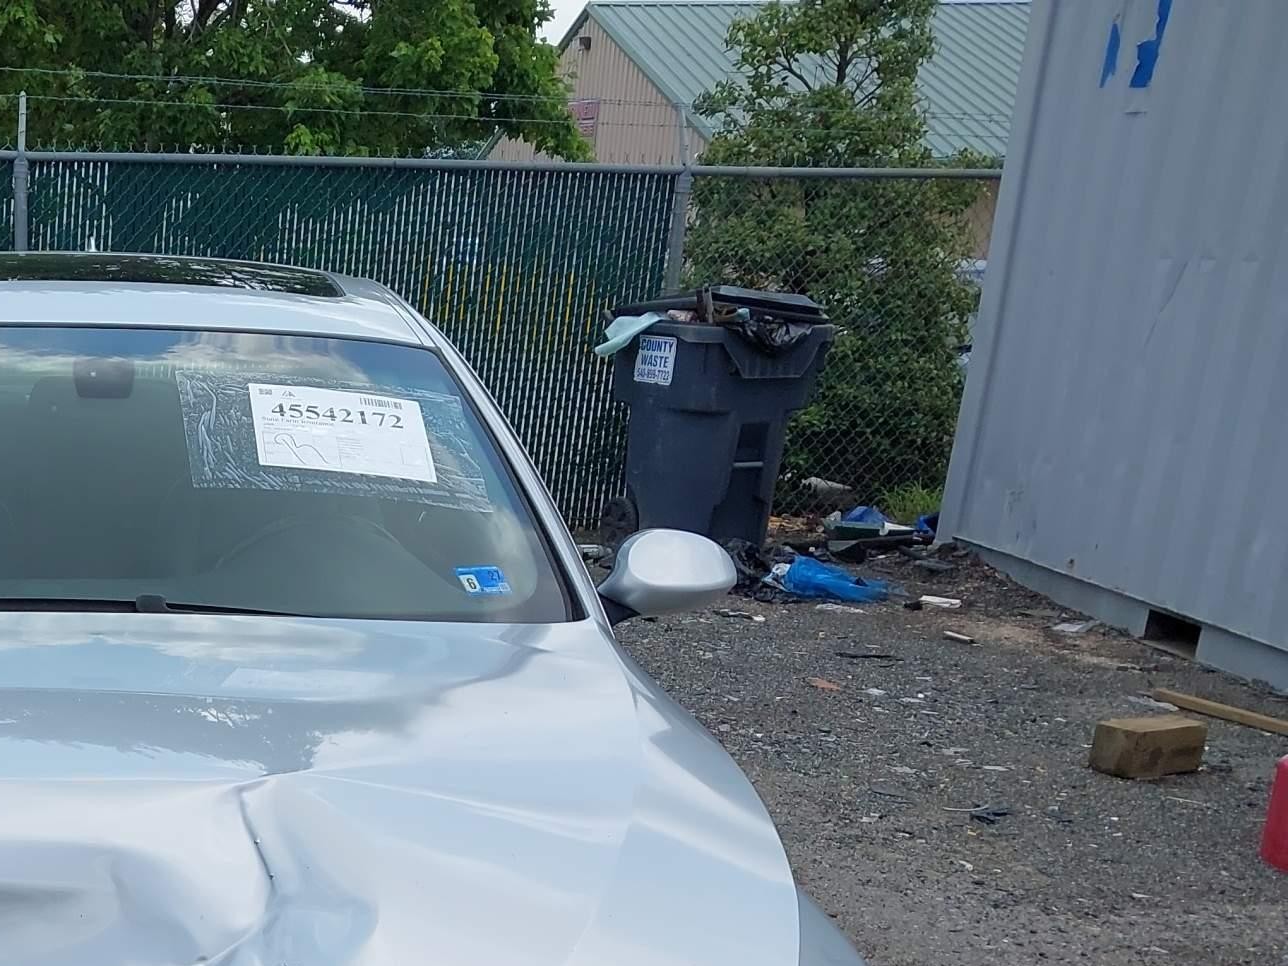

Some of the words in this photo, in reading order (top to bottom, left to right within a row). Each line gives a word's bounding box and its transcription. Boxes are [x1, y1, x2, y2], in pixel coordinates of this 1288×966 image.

[641, 338, 673, 352] COUNTY
[641, 353, 669, 368] WASTE
[271, 402, 404, 429] 45542172
[466, 577, 477, 590] 6
